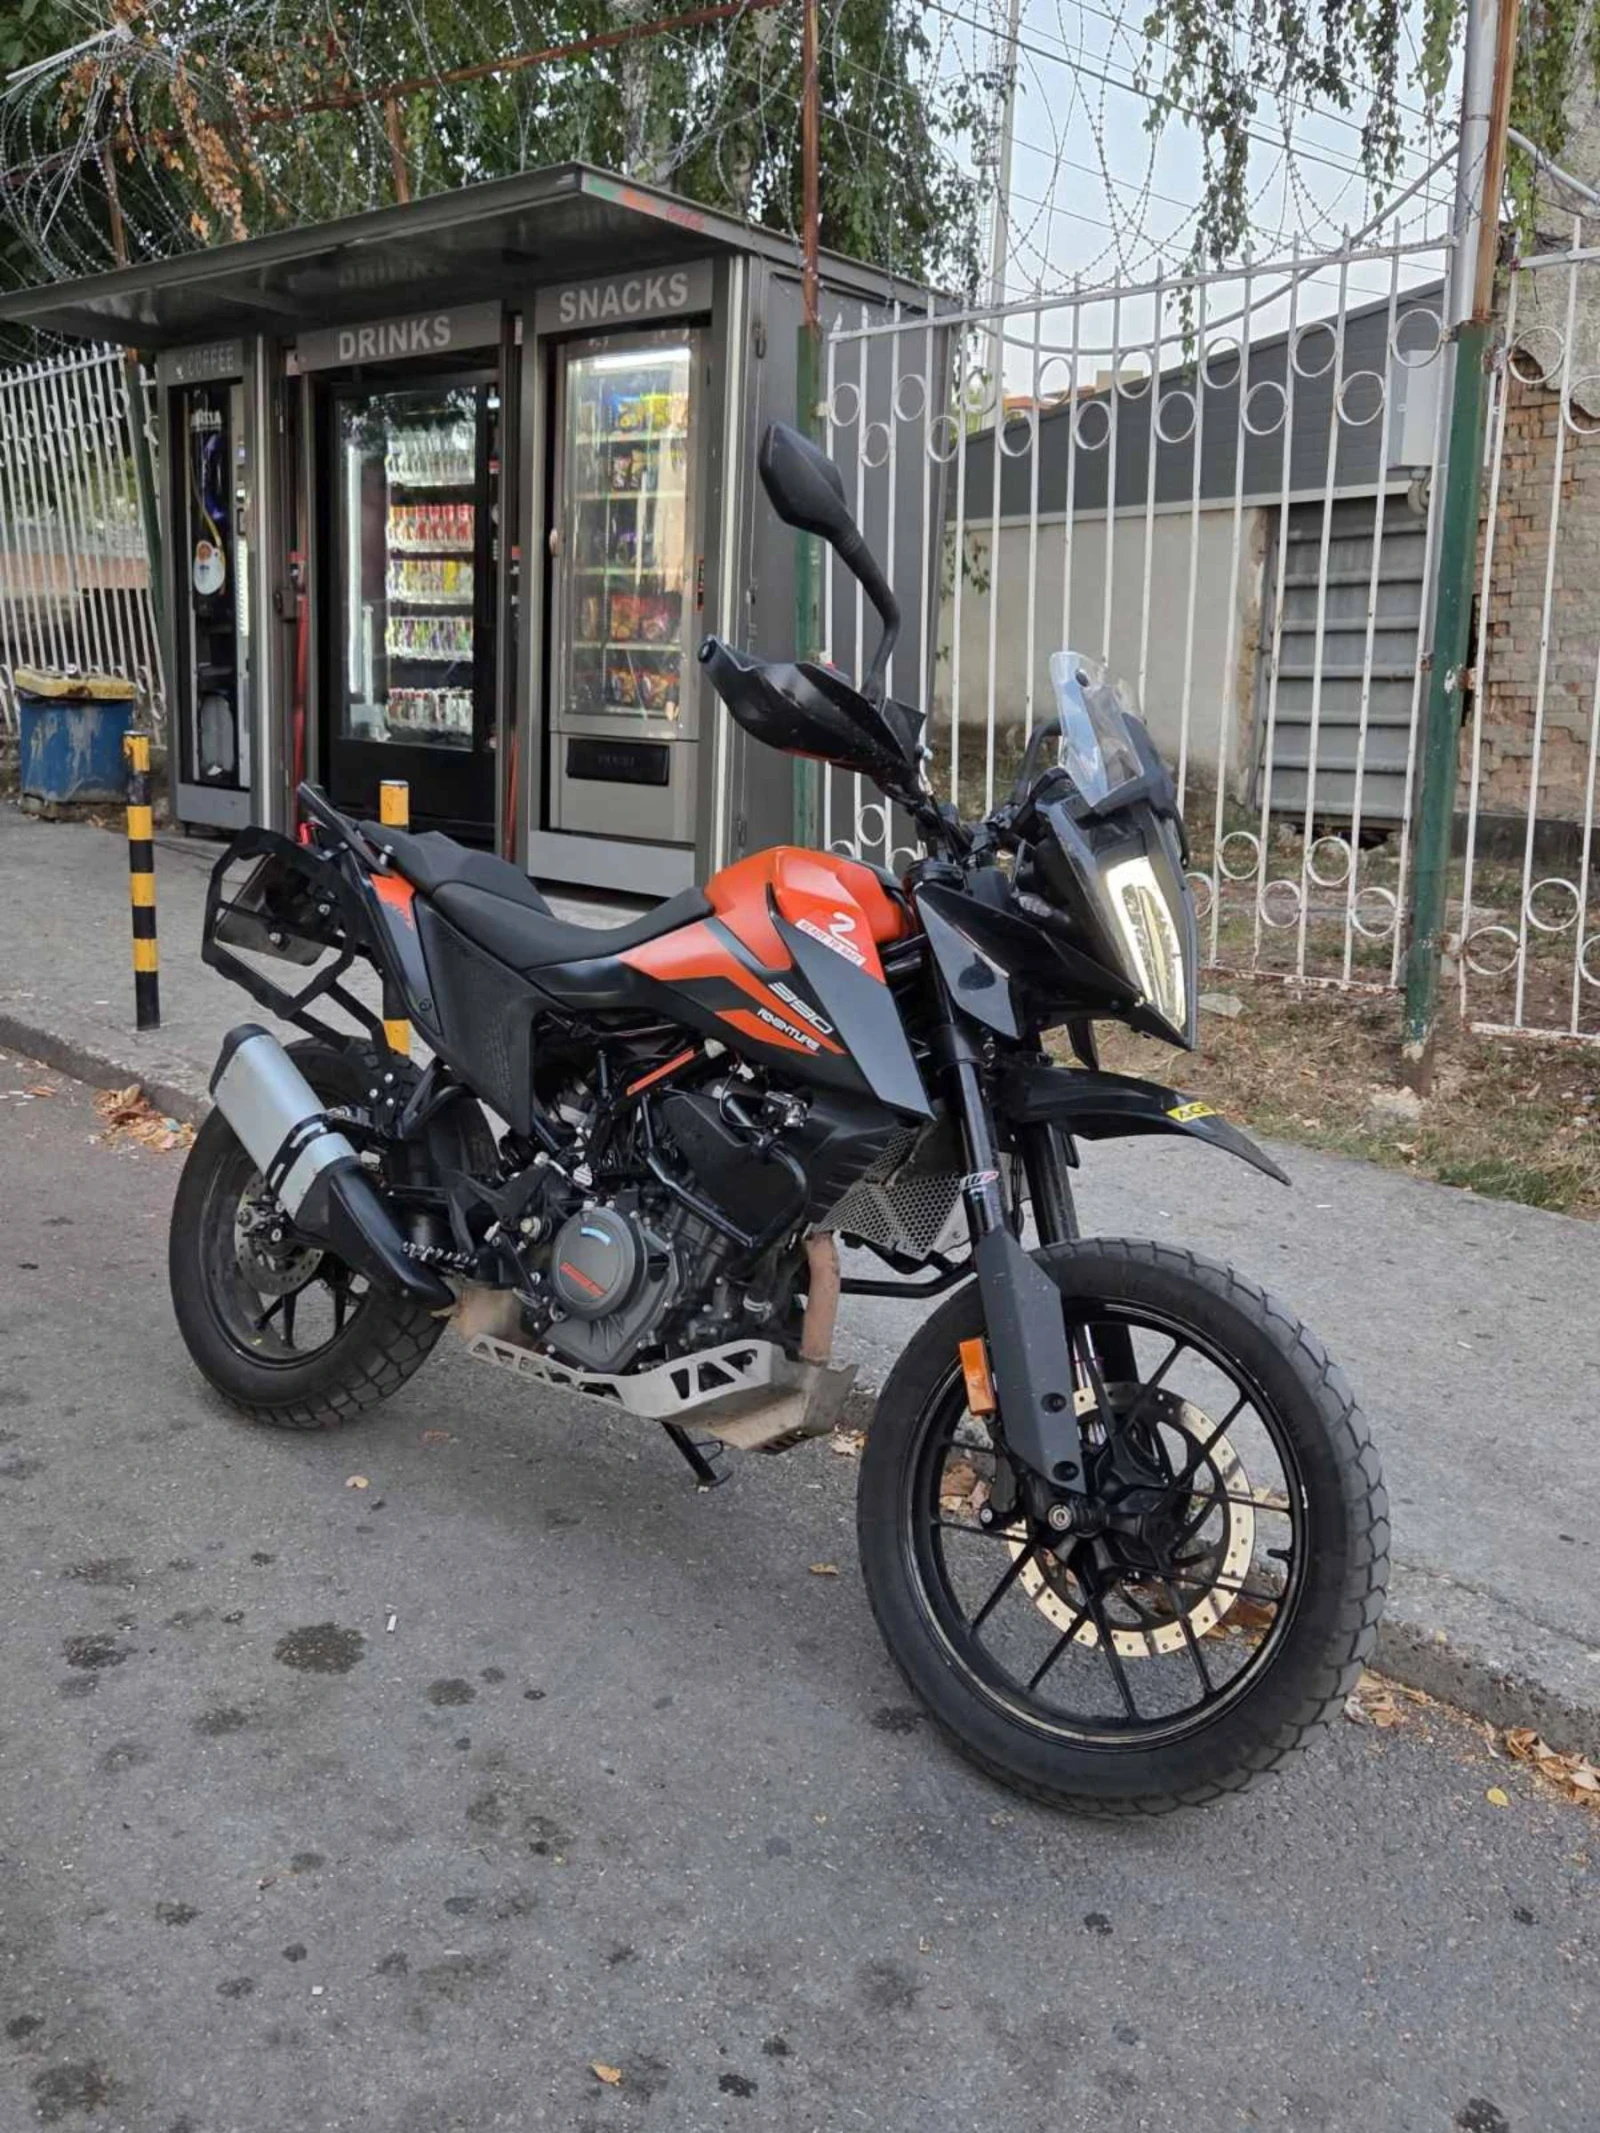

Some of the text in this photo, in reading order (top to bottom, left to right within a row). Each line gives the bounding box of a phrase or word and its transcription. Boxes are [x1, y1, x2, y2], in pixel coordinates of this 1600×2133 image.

[559, 271, 689, 324] SNACKS
[339, 315, 452, 361] DRINKS
[187, 345, 235, 378] COFFEE
[828, 911, 860, 952] 2
[756, 1007, 821, 1052] ADVENTURE
[767, 981, 834, 1035] 390
